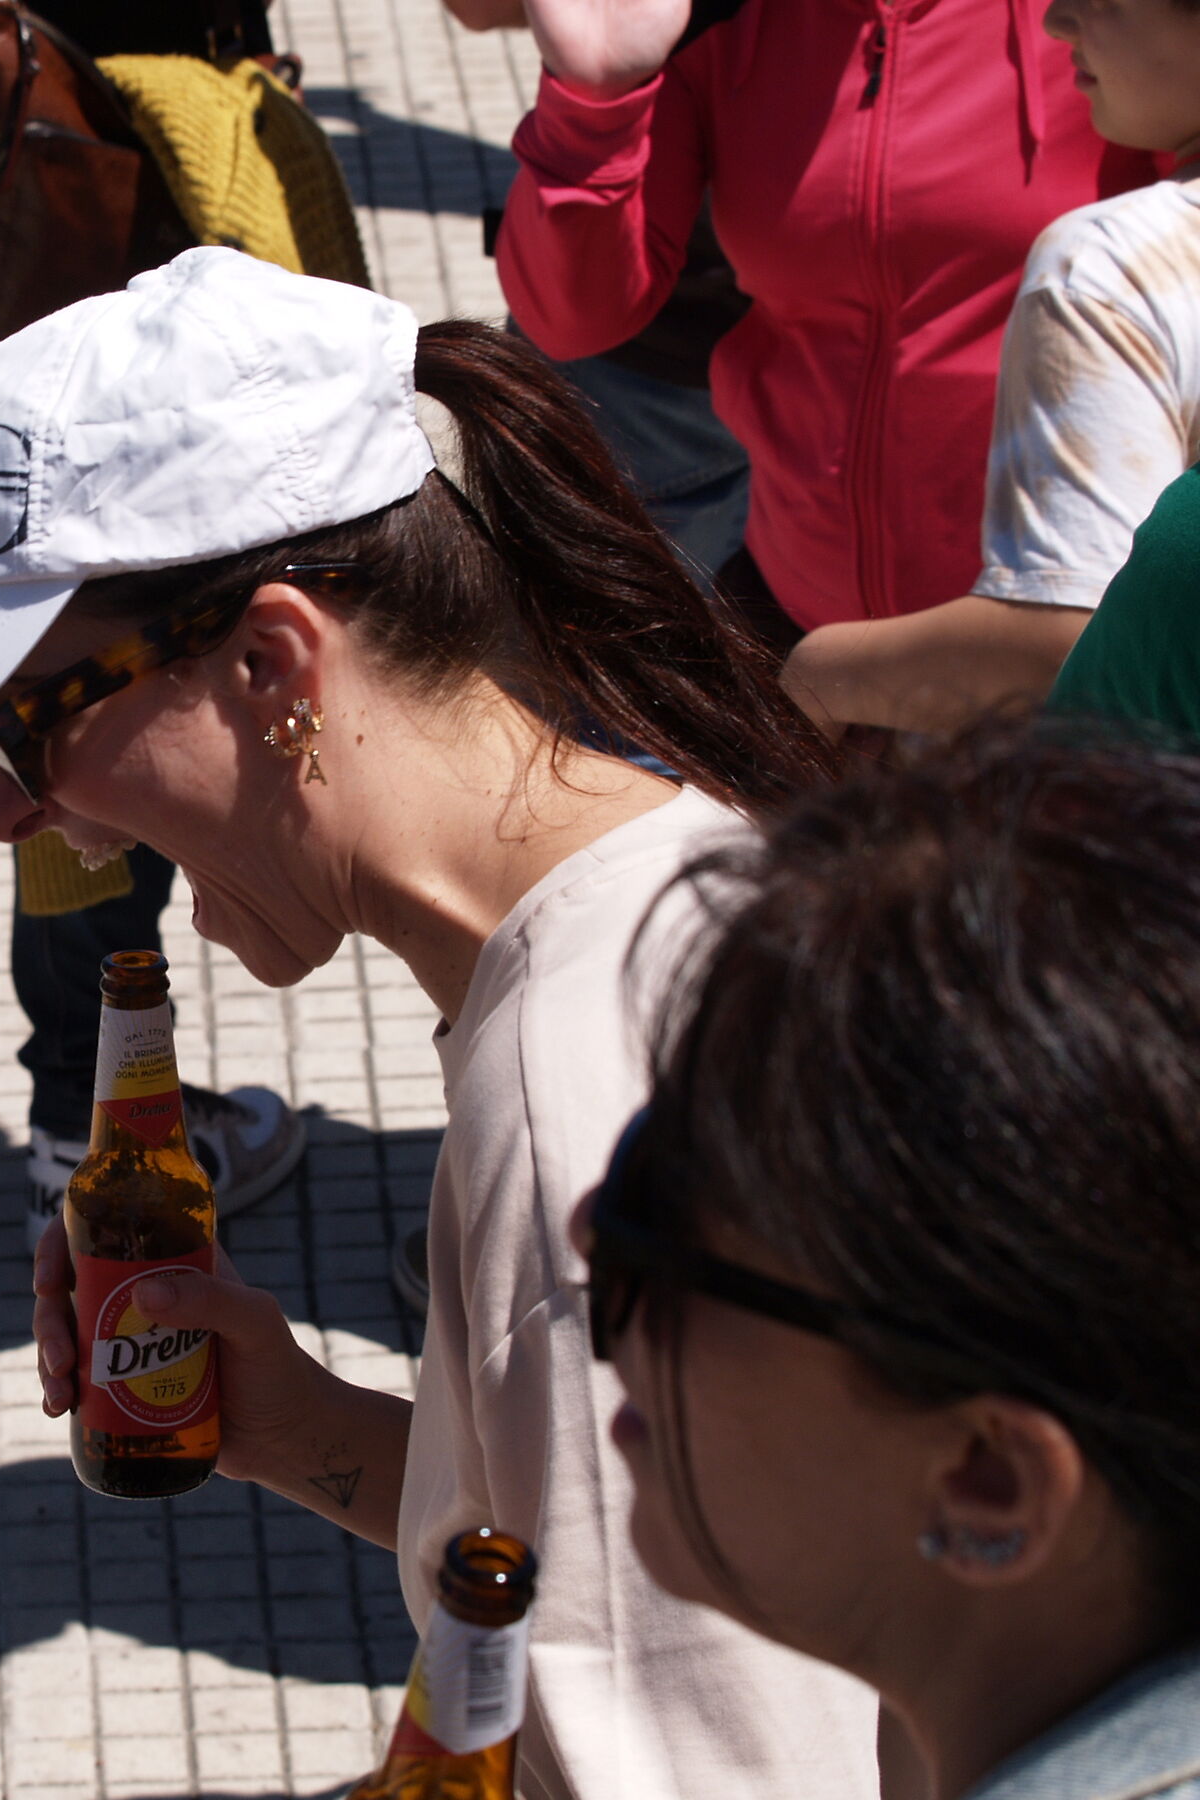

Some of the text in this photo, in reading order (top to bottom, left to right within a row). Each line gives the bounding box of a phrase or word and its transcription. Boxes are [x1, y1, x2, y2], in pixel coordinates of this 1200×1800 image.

[125, 1031, 143, 1043] DAL
[118, 1060, 136, 1069] CHE
[115, 1071, 138, 1079] OGNI
[153, 1383, 186, 1399] 1773
